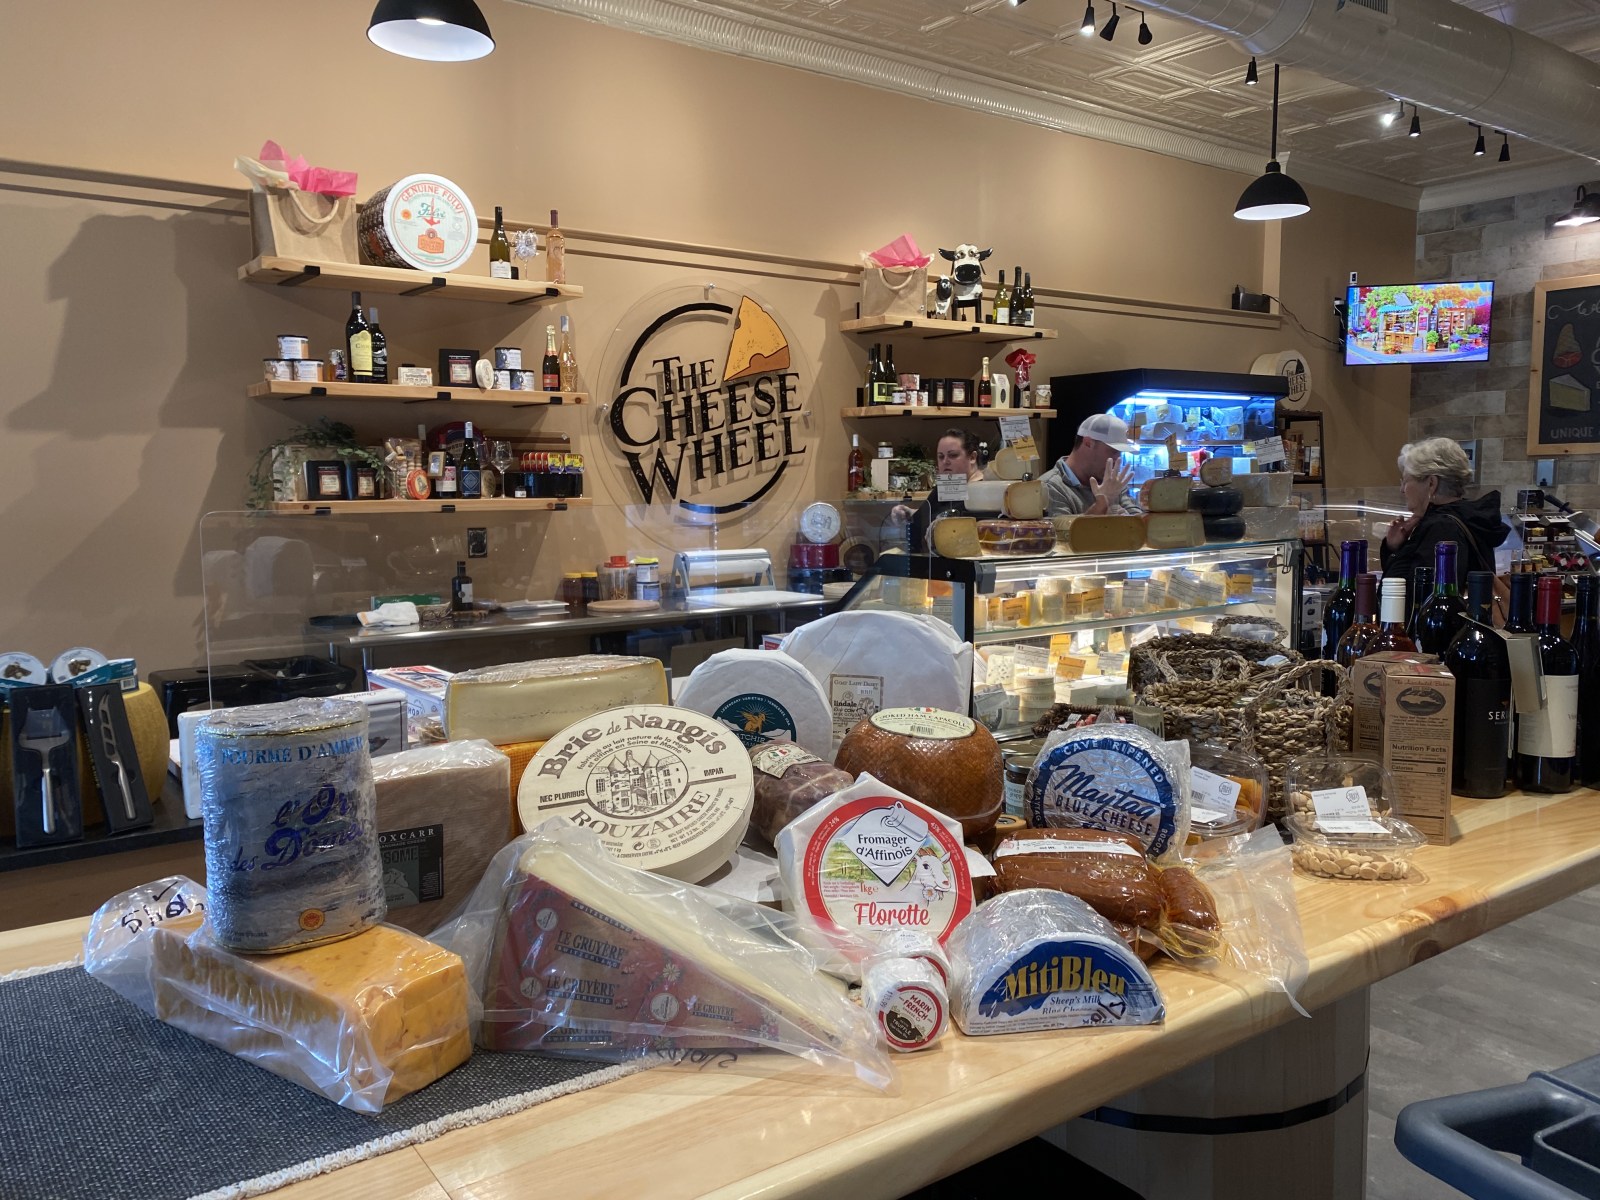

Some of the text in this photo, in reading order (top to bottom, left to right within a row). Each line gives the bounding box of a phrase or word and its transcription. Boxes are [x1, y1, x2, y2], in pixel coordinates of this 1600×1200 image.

[401, 184, 464, 214] GENUINE FULVI
[653, 356, 716, 395] THE
[1288, 374, 1307, 387] HEESE
[1290, 383, 1308, 395] HEEL
[610, 372, 802, 447] CHEESE
[1550, 426, 1594, 439] UNIQUE
[621, 417, 806, 504] WHEEL
[720, 698, 741, 714] LEGENDARY
[1488, 711, 1508, 720] SER
[1360, 723, 1380, 731] Nutriti
[298, 736, 363, 761] D'AMBER
[537, 714, 727, 779] Brie de Nangis
[659, 740, 682, 754] Marne
[1392, 743, 1447, 753] Nutrition Facts
[1063, 739, 1164, 783] CAVE RIPENED
[703, 767, 724, 777] IMPAR
[539, 789, 585, 803] NEC PLURIBUS
[1051, 763, 1163, 820] Maytag
[1034, 787, 1043, 821] MAYTAG
[569, 790, 710, 839] ROUZAIRE
[829, 816, 840, 828] 24%
[1056, 794, 1153, 836] BLUE CHEESE
[378, 828, 435, 843] OXCARR
[930, 822, 941, 833] 45%
[857, 834, 908, 851] Fromager
[1153, 828, 1168, 853] 50208
[383, 846, 419, 864] SOME
[855, 846, 913, 863] d'Affinois
[573, 901, 632, 933] SWITZERLAND
[854, 902, 931, 926] Florette
[557, 930, 625, 961] LE GRUYÈRE
[557, 946, 619, 969] SWITZERLAND
[548, 976, 616, 997] LE GRUYÈRE
[1004, 956, 1130, 1002] MitiBleu
[903, 999, 928, 1020] FRENCH
[910, 994, 932, 1013] MARIN
[1050, 995, 1102, 1005] Sheep's Milk
[703, 1004, 735, 1016] GRUYÈRE
[892, 1019, 912, 1036] TRUFFLE
